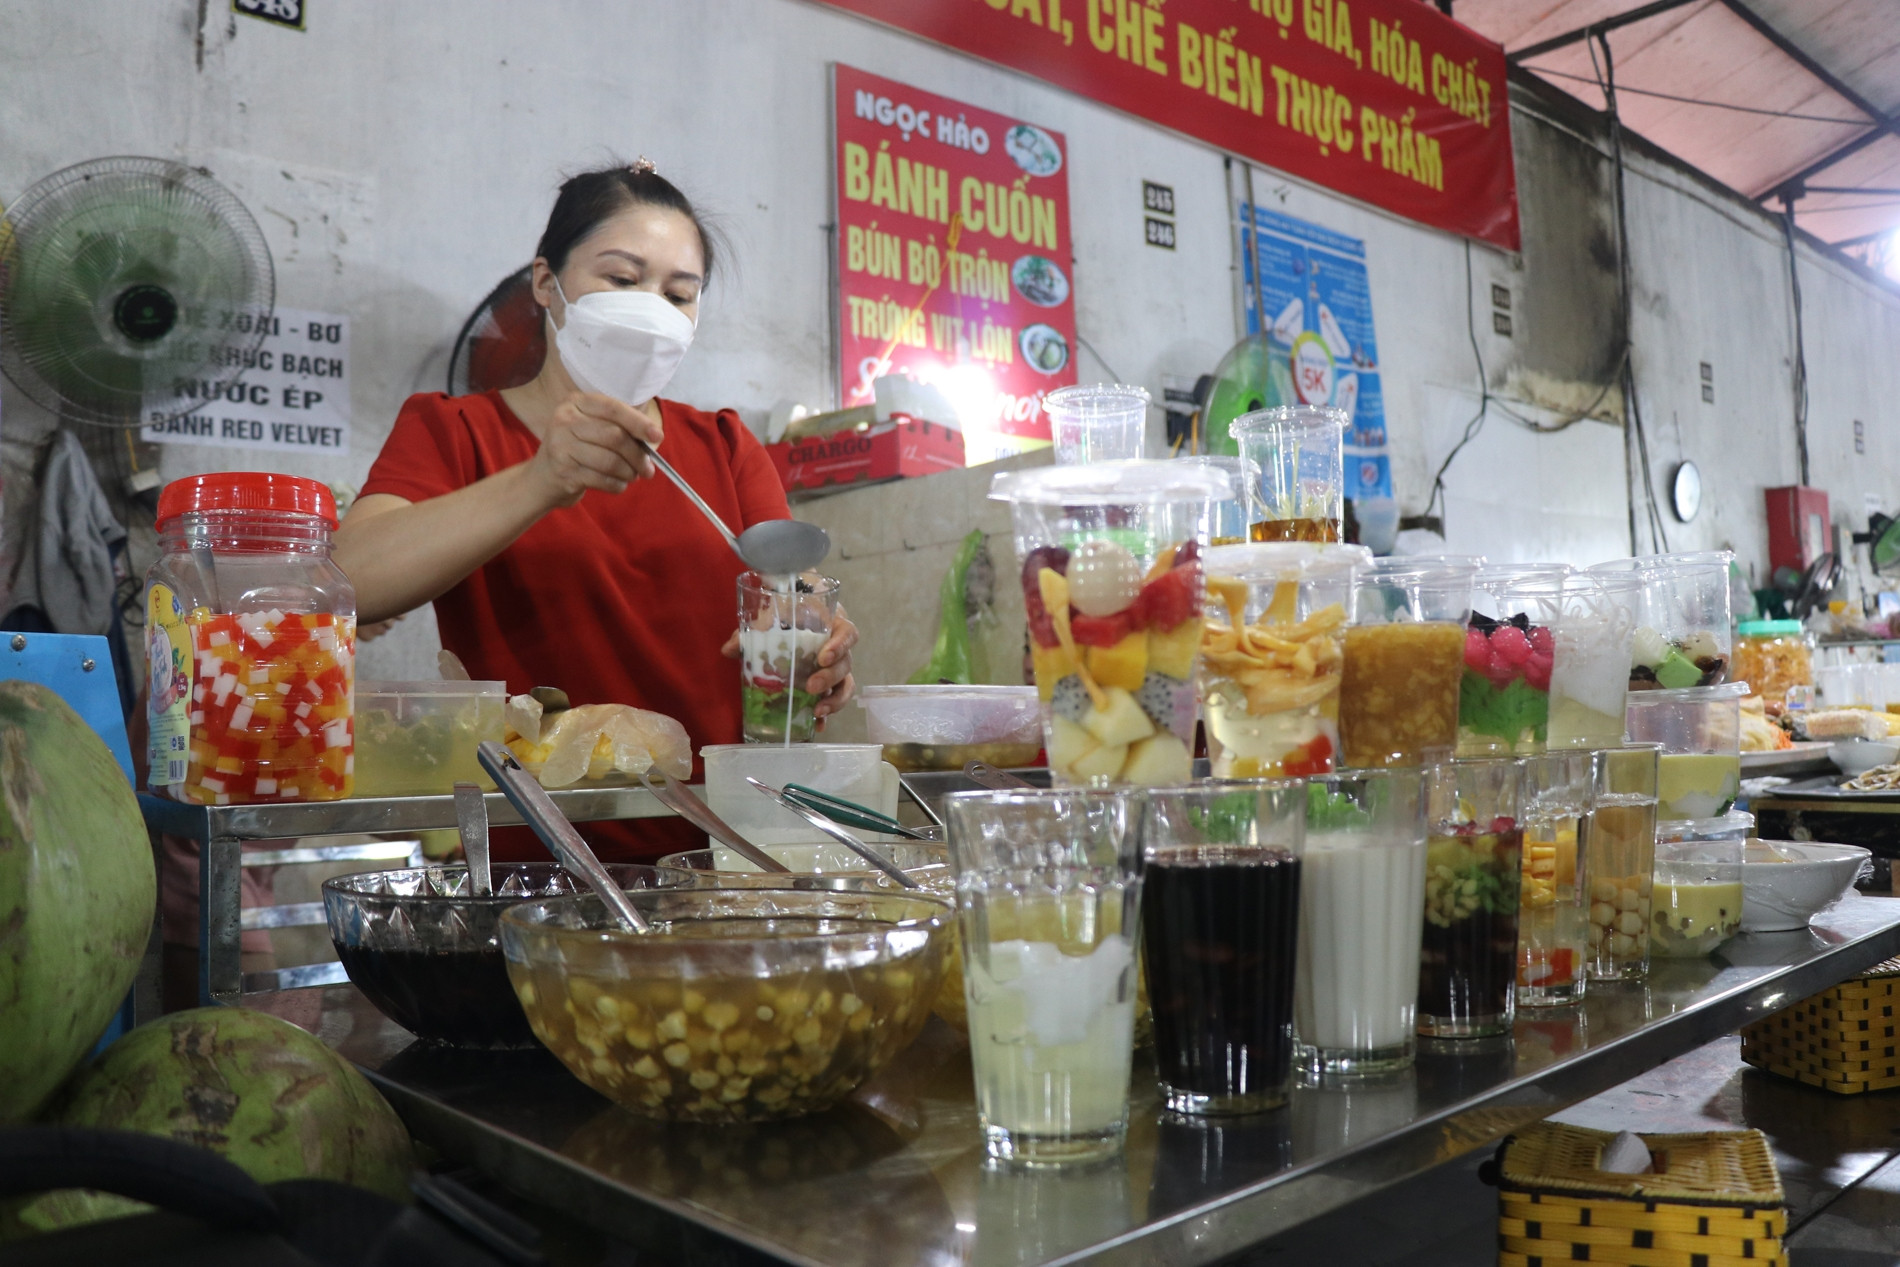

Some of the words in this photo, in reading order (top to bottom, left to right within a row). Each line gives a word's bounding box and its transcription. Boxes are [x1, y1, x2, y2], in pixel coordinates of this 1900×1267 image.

[1370, 17, 1426, 95] HÓA
[1432, 53, 1491, 128] CHẤT
[855, 89, 931, 142] NGỌC
[1178, 22, 1263, 117] BIẾN
[1271, 65, 1354, 157] THỰC
[1361, 106, 1444, 192] PHẨM
[844, 139, 948, 225] BÁNH
[960, 174, 1057, 250] CUỐN
[847, 220, 902, 281] BÚN
[907, 233, 941, 290] BÒ
[946, 247, 1010, 310] TRỘN
[307, 321, 342, 344] BƠ
[848, 294, 927, 348] TRỨNG
[969, 316, 1013, 370] LỘN
[282, 353, 343, 380] BẠCH
[1304, 367, 1327, 394] 5K
[222, 418, 264, 441] RED
[271, 422, 343, 448] VELVET
